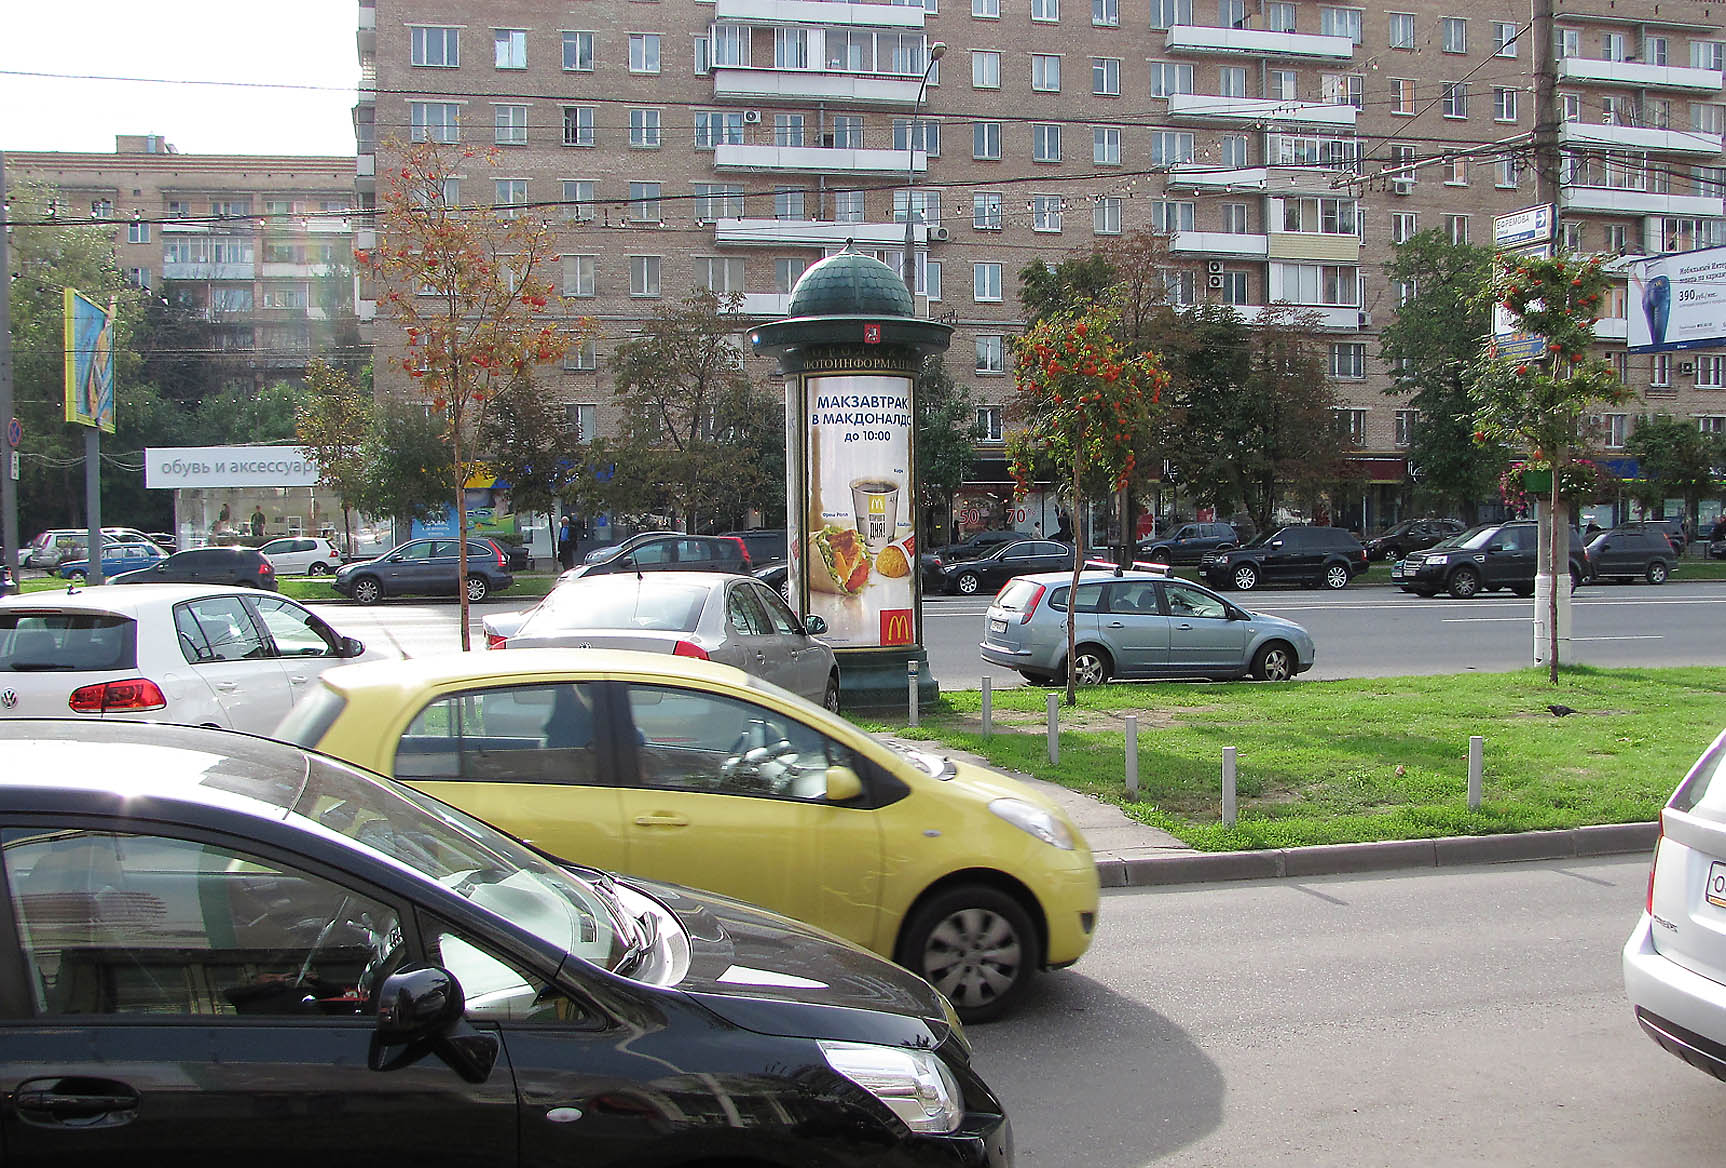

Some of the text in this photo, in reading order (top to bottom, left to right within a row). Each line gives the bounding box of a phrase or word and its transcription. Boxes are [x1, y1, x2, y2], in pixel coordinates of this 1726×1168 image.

[1497, 215, 1529, 230] ЕФРЕМОВА
[1680, 289, 1695, 301] 390
[817, 395, 908, 409] МАКЗАВТРАК
[812, 412, 912, 428] В МАКДОНАЛДС
[844, 430, 891, 442] до 10:00
[161, 459, 210, 477] обувь
[215, 463, 226, 473] и
[960, 509, 979, 525] 50
